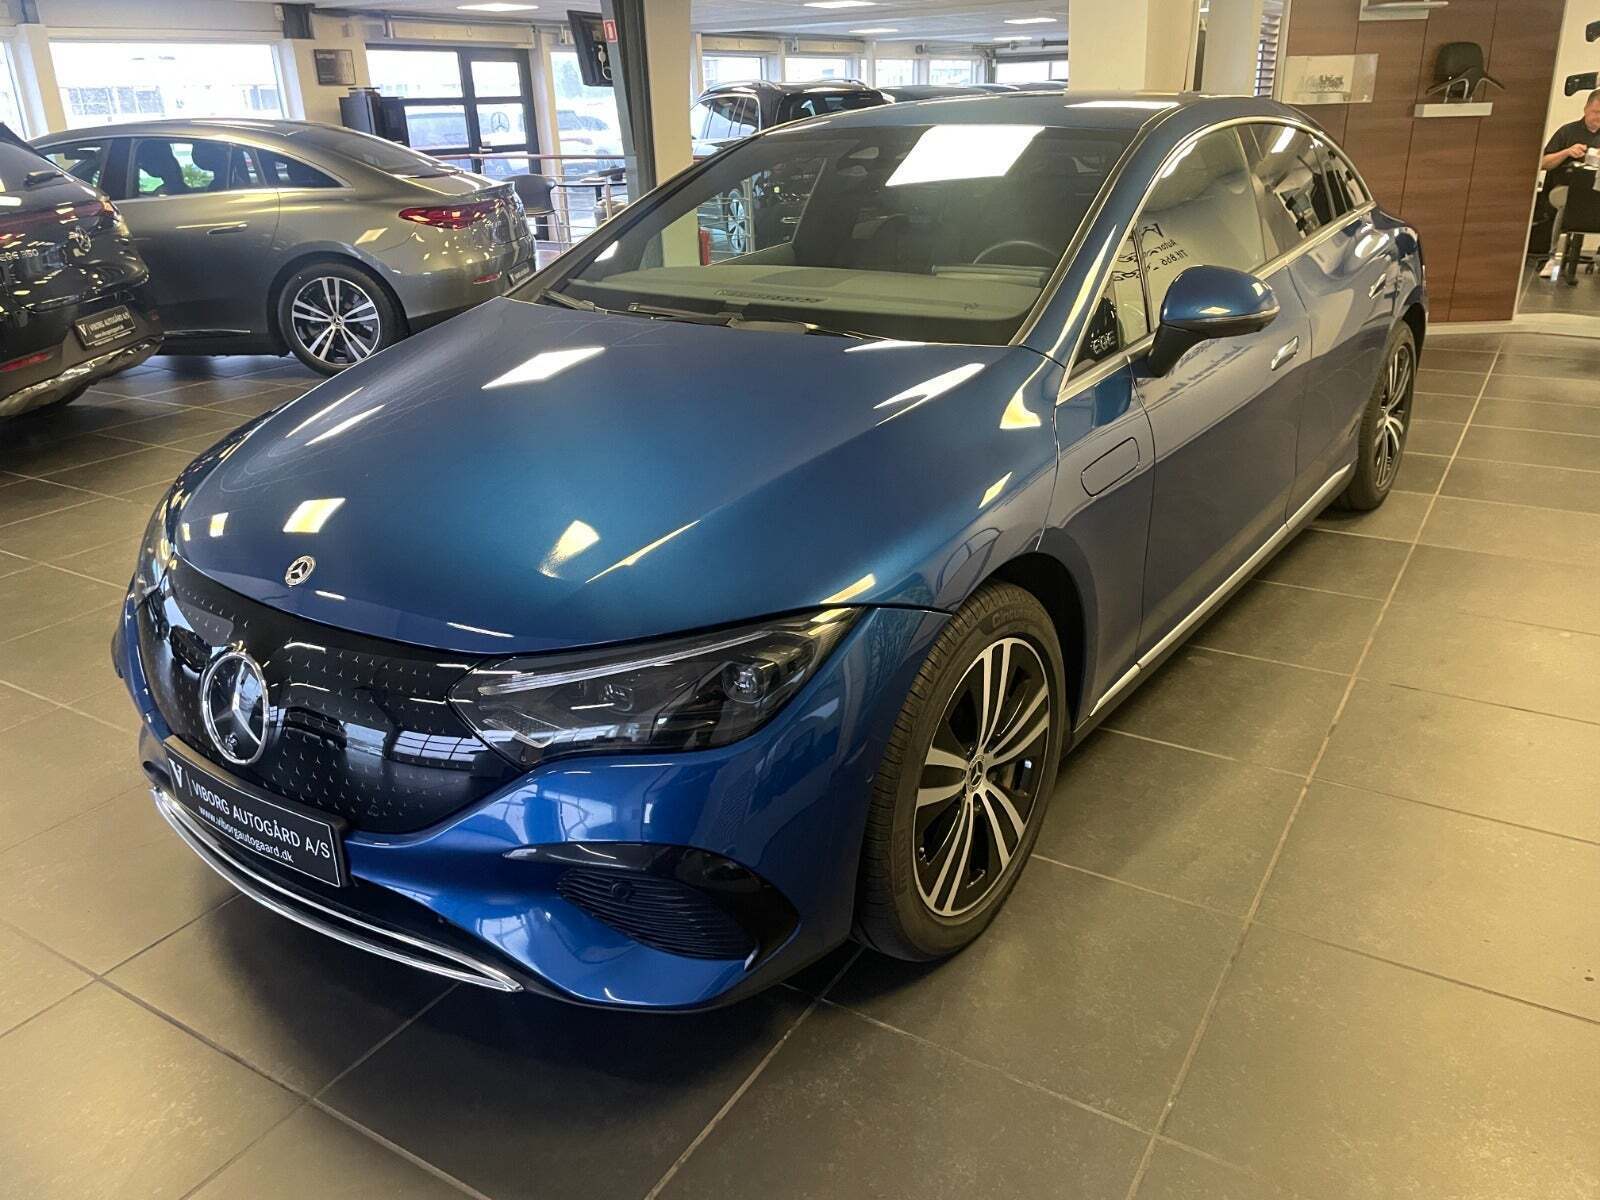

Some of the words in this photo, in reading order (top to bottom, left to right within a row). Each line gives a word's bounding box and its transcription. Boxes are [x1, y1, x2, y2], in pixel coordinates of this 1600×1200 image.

[191, 779, 230, 816] VIBORG
[233, 805, 301, 848] AUTOGÅRD
[305, 836, 331, 859] A/S
[198, 805, 295, 864] www.viborgautogaard.dk
